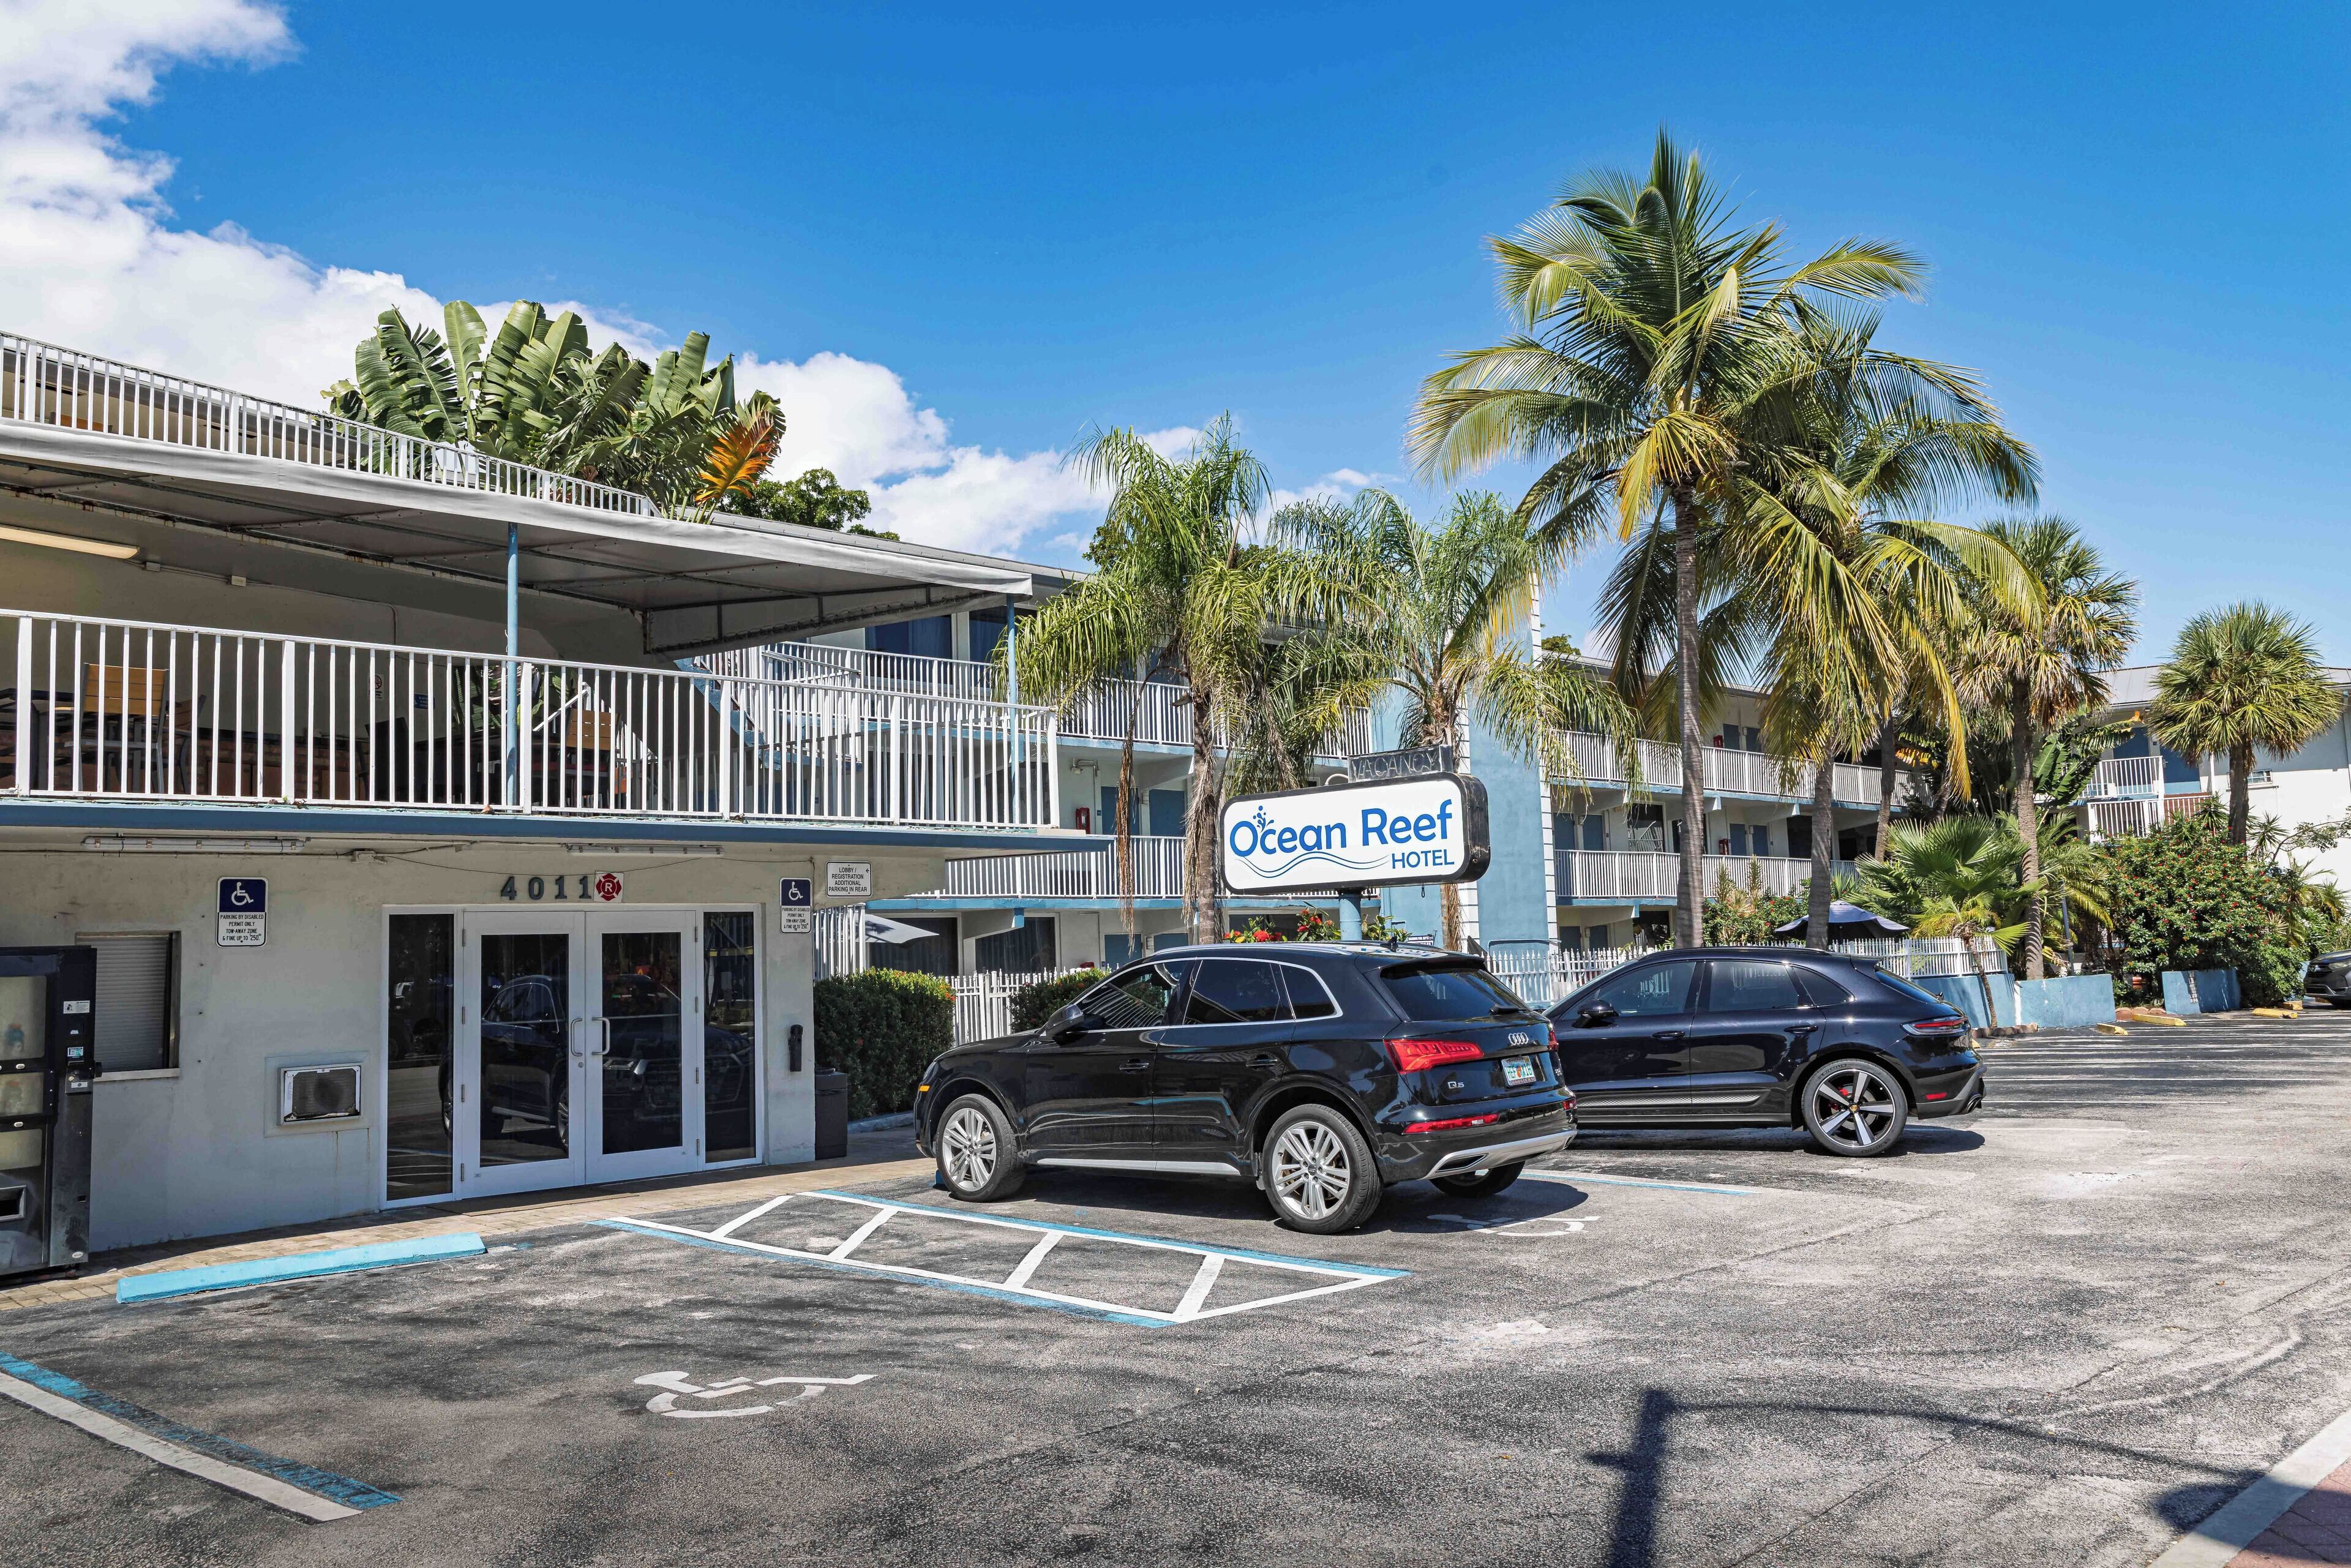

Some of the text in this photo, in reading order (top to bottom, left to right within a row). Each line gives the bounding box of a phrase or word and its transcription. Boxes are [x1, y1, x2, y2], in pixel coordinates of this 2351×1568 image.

[1352, 752, 1437, 779] VACANCY
[1230, 799, 1453, 857] Ocean Reef
[1392, 849, 1455, 869] HOTEL
[500, 875, 592, 901] 4011
[604, 882, 613, 892] R
